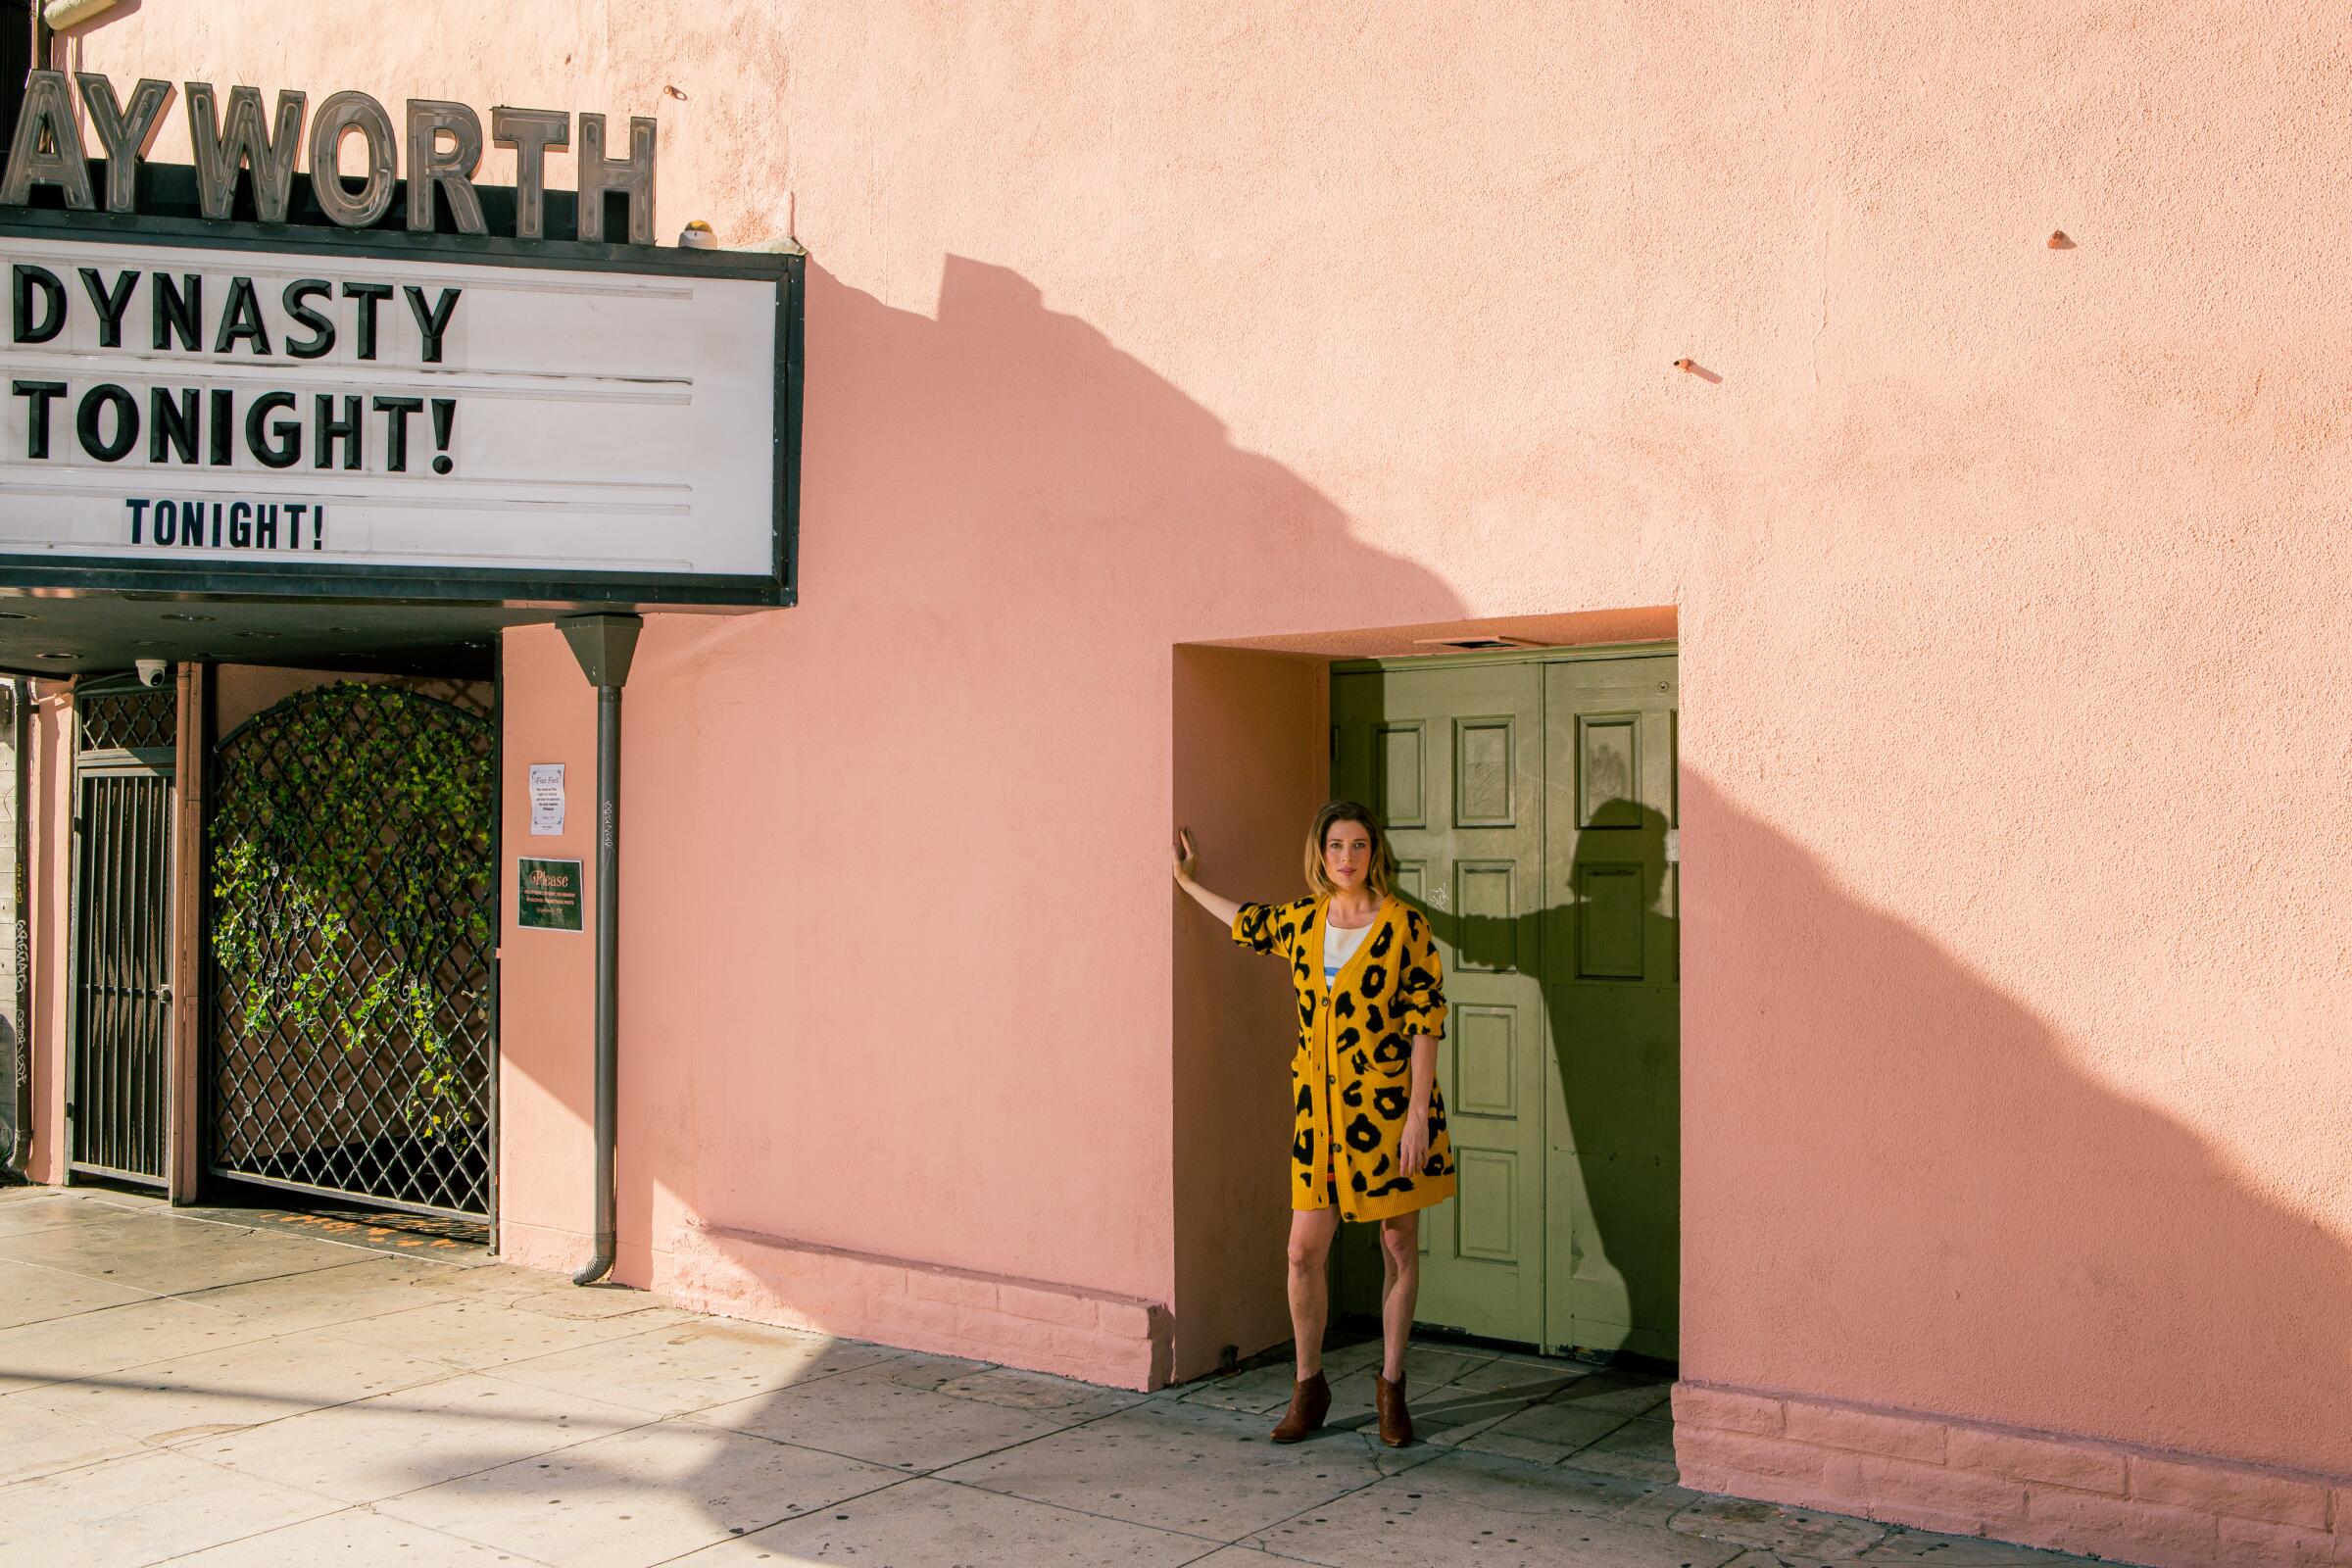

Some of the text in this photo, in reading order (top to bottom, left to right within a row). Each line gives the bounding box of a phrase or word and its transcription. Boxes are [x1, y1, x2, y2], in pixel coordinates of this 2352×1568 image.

[0, 69, 658, 245] AYWORTH
[12, 262, 464, 364] DYNASTY
[12, 379, 458, 475] TONIGHT!
[125, 498, 323, 551] TONIGHT!
[529, 869, 568, 888] Please
